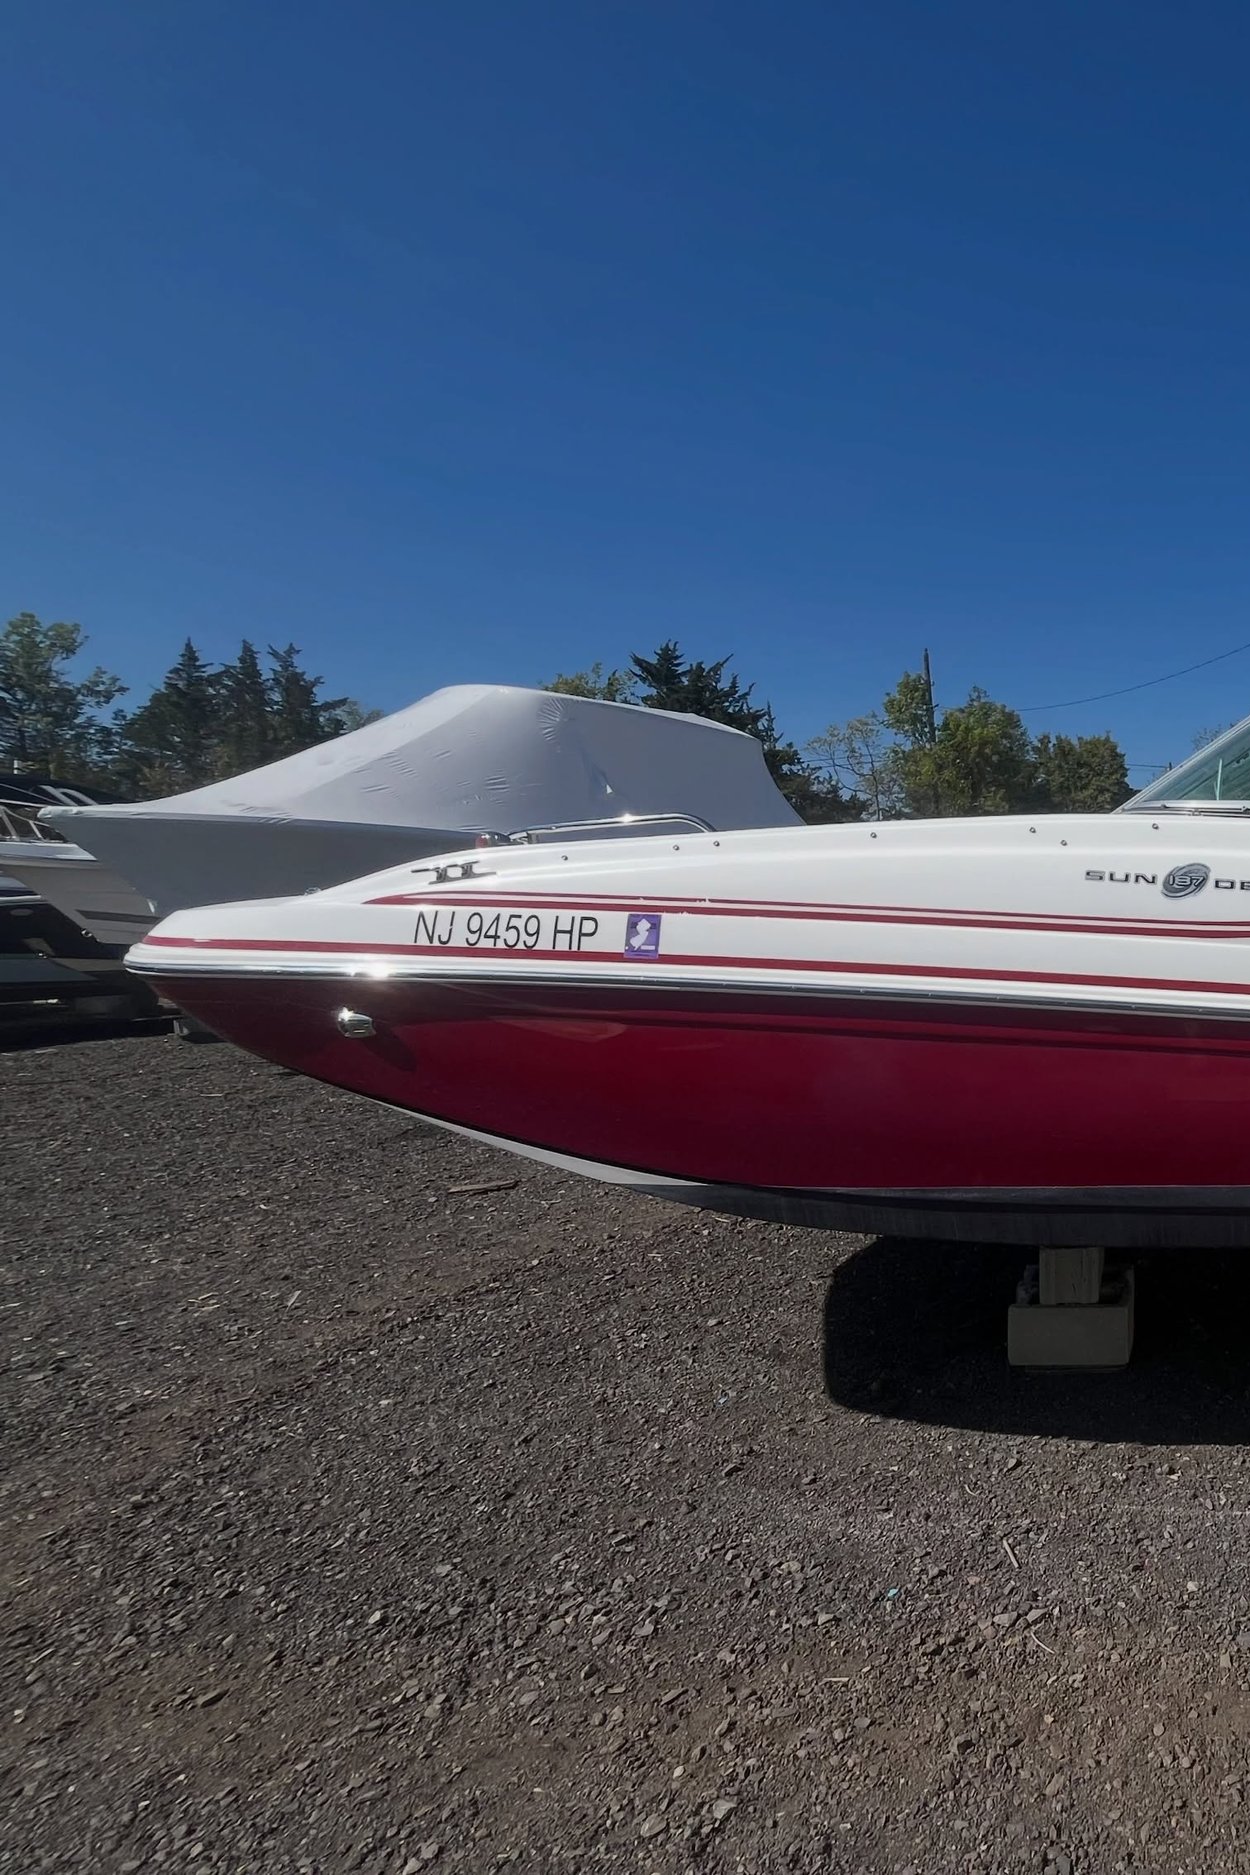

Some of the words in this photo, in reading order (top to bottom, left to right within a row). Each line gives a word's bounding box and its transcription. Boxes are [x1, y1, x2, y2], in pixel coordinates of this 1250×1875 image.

[1084, 870, 1157, 885] SUN
[414, 911, 456, 944] NJ
[465, 912, 541, 949] 9459
[552, 916, 598, 951] HP
